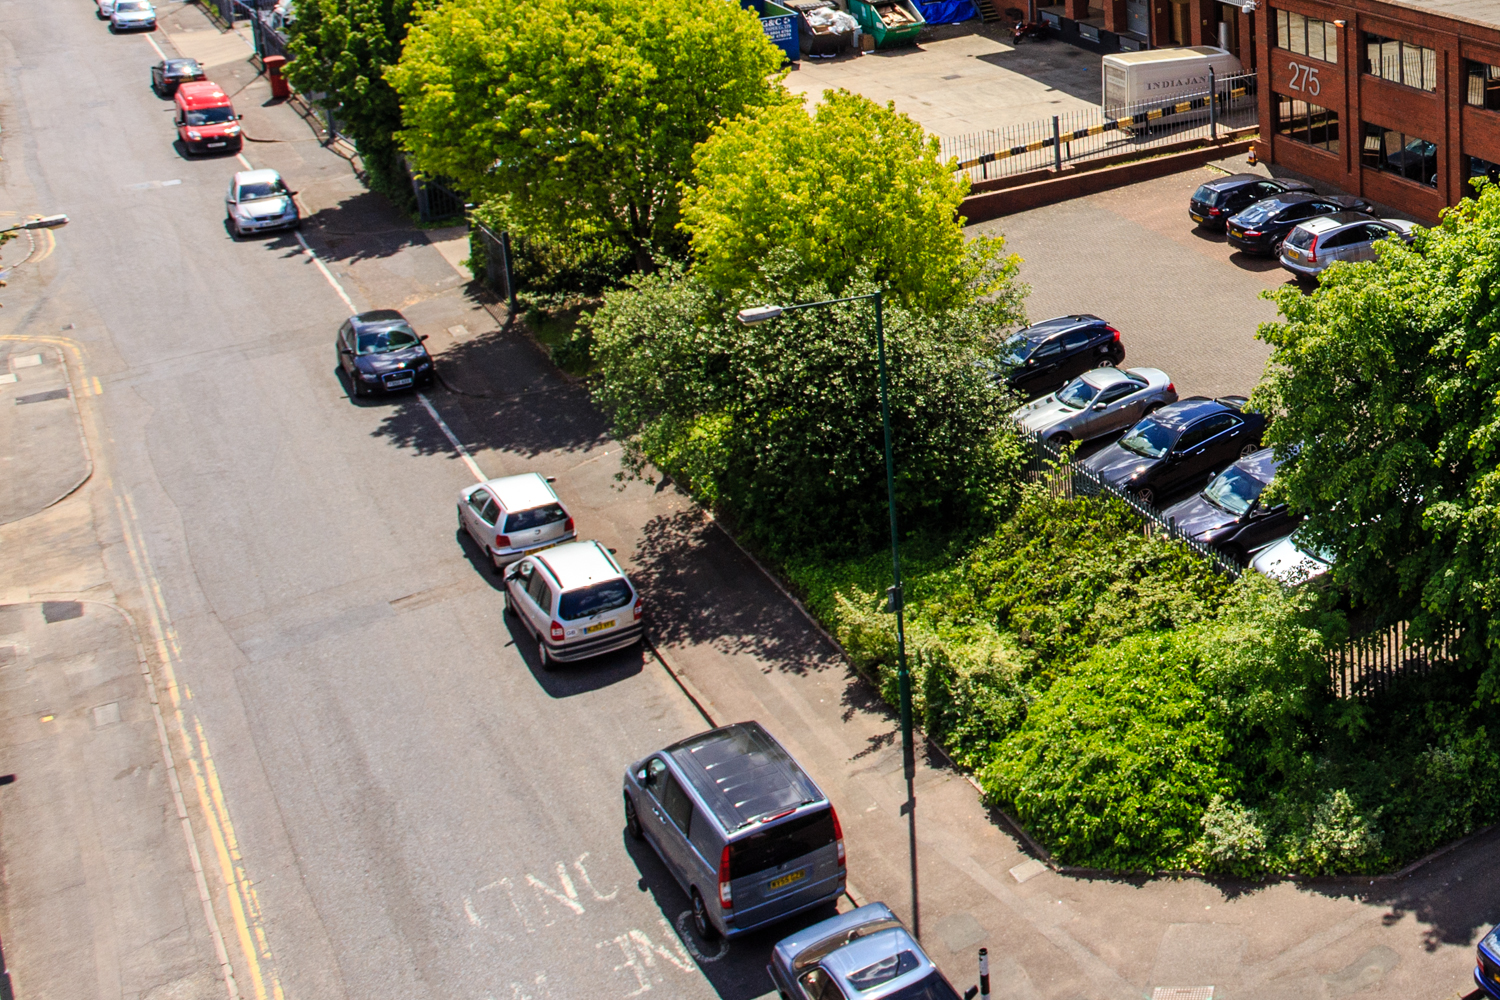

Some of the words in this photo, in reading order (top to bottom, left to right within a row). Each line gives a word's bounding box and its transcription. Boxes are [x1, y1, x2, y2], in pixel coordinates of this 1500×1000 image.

[761, 18, 782, 27] G&C
[1289, 61, 1320, 96] 275
[1146, 79, 1183, 91] INDIA
